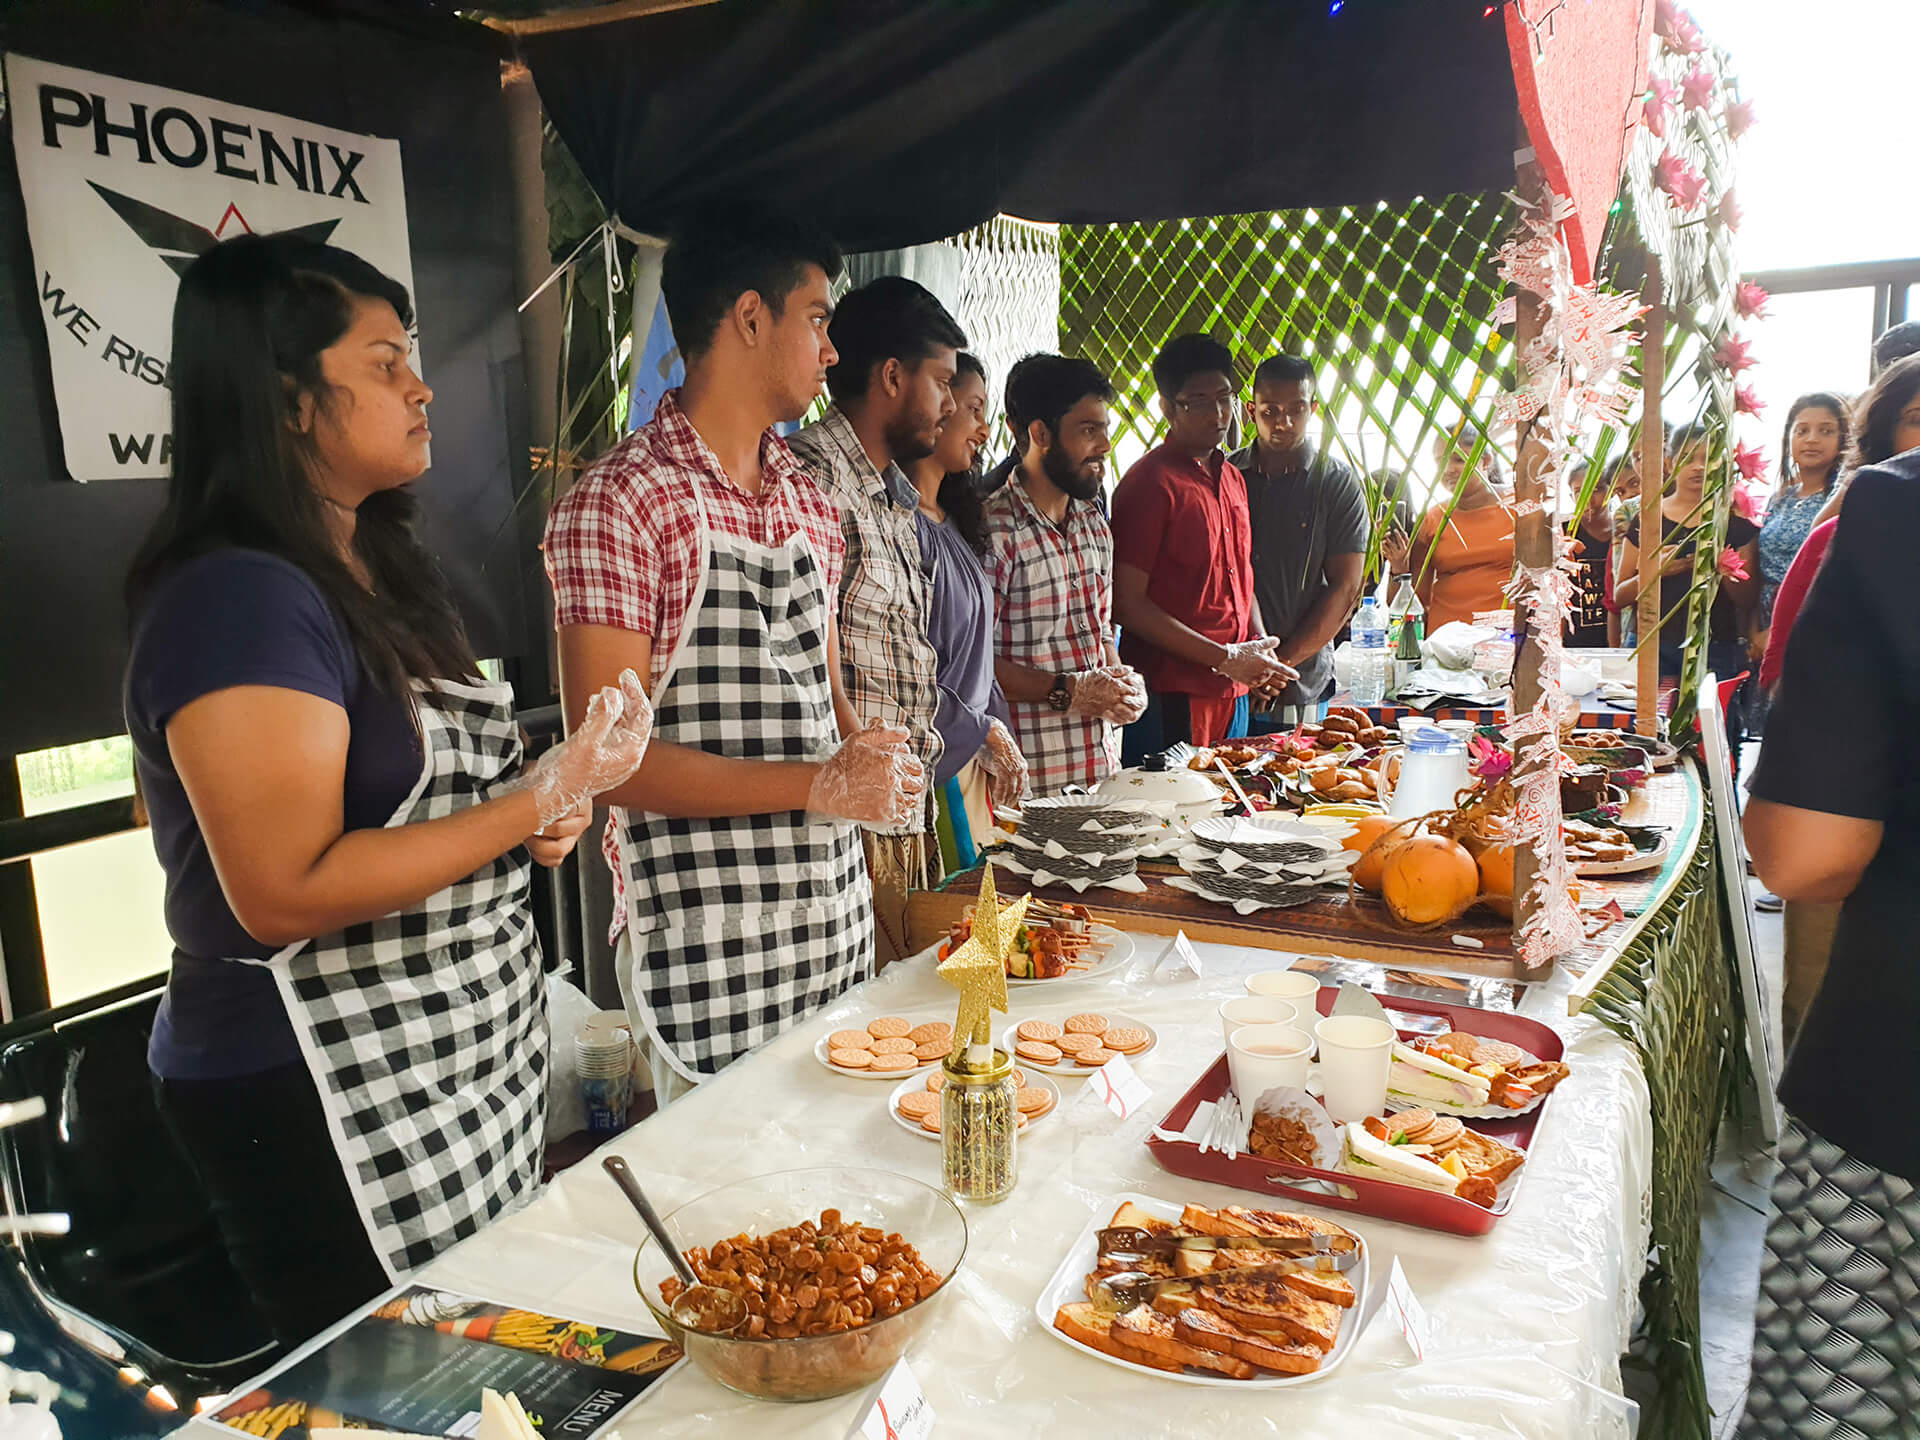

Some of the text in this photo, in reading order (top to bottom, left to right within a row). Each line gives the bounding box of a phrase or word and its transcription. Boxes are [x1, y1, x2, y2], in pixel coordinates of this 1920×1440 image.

[39, 84, 370, 204] PHOENIX
[42, 271, 101, 347] WE
[563, 1390, 624, 1433] MENU
